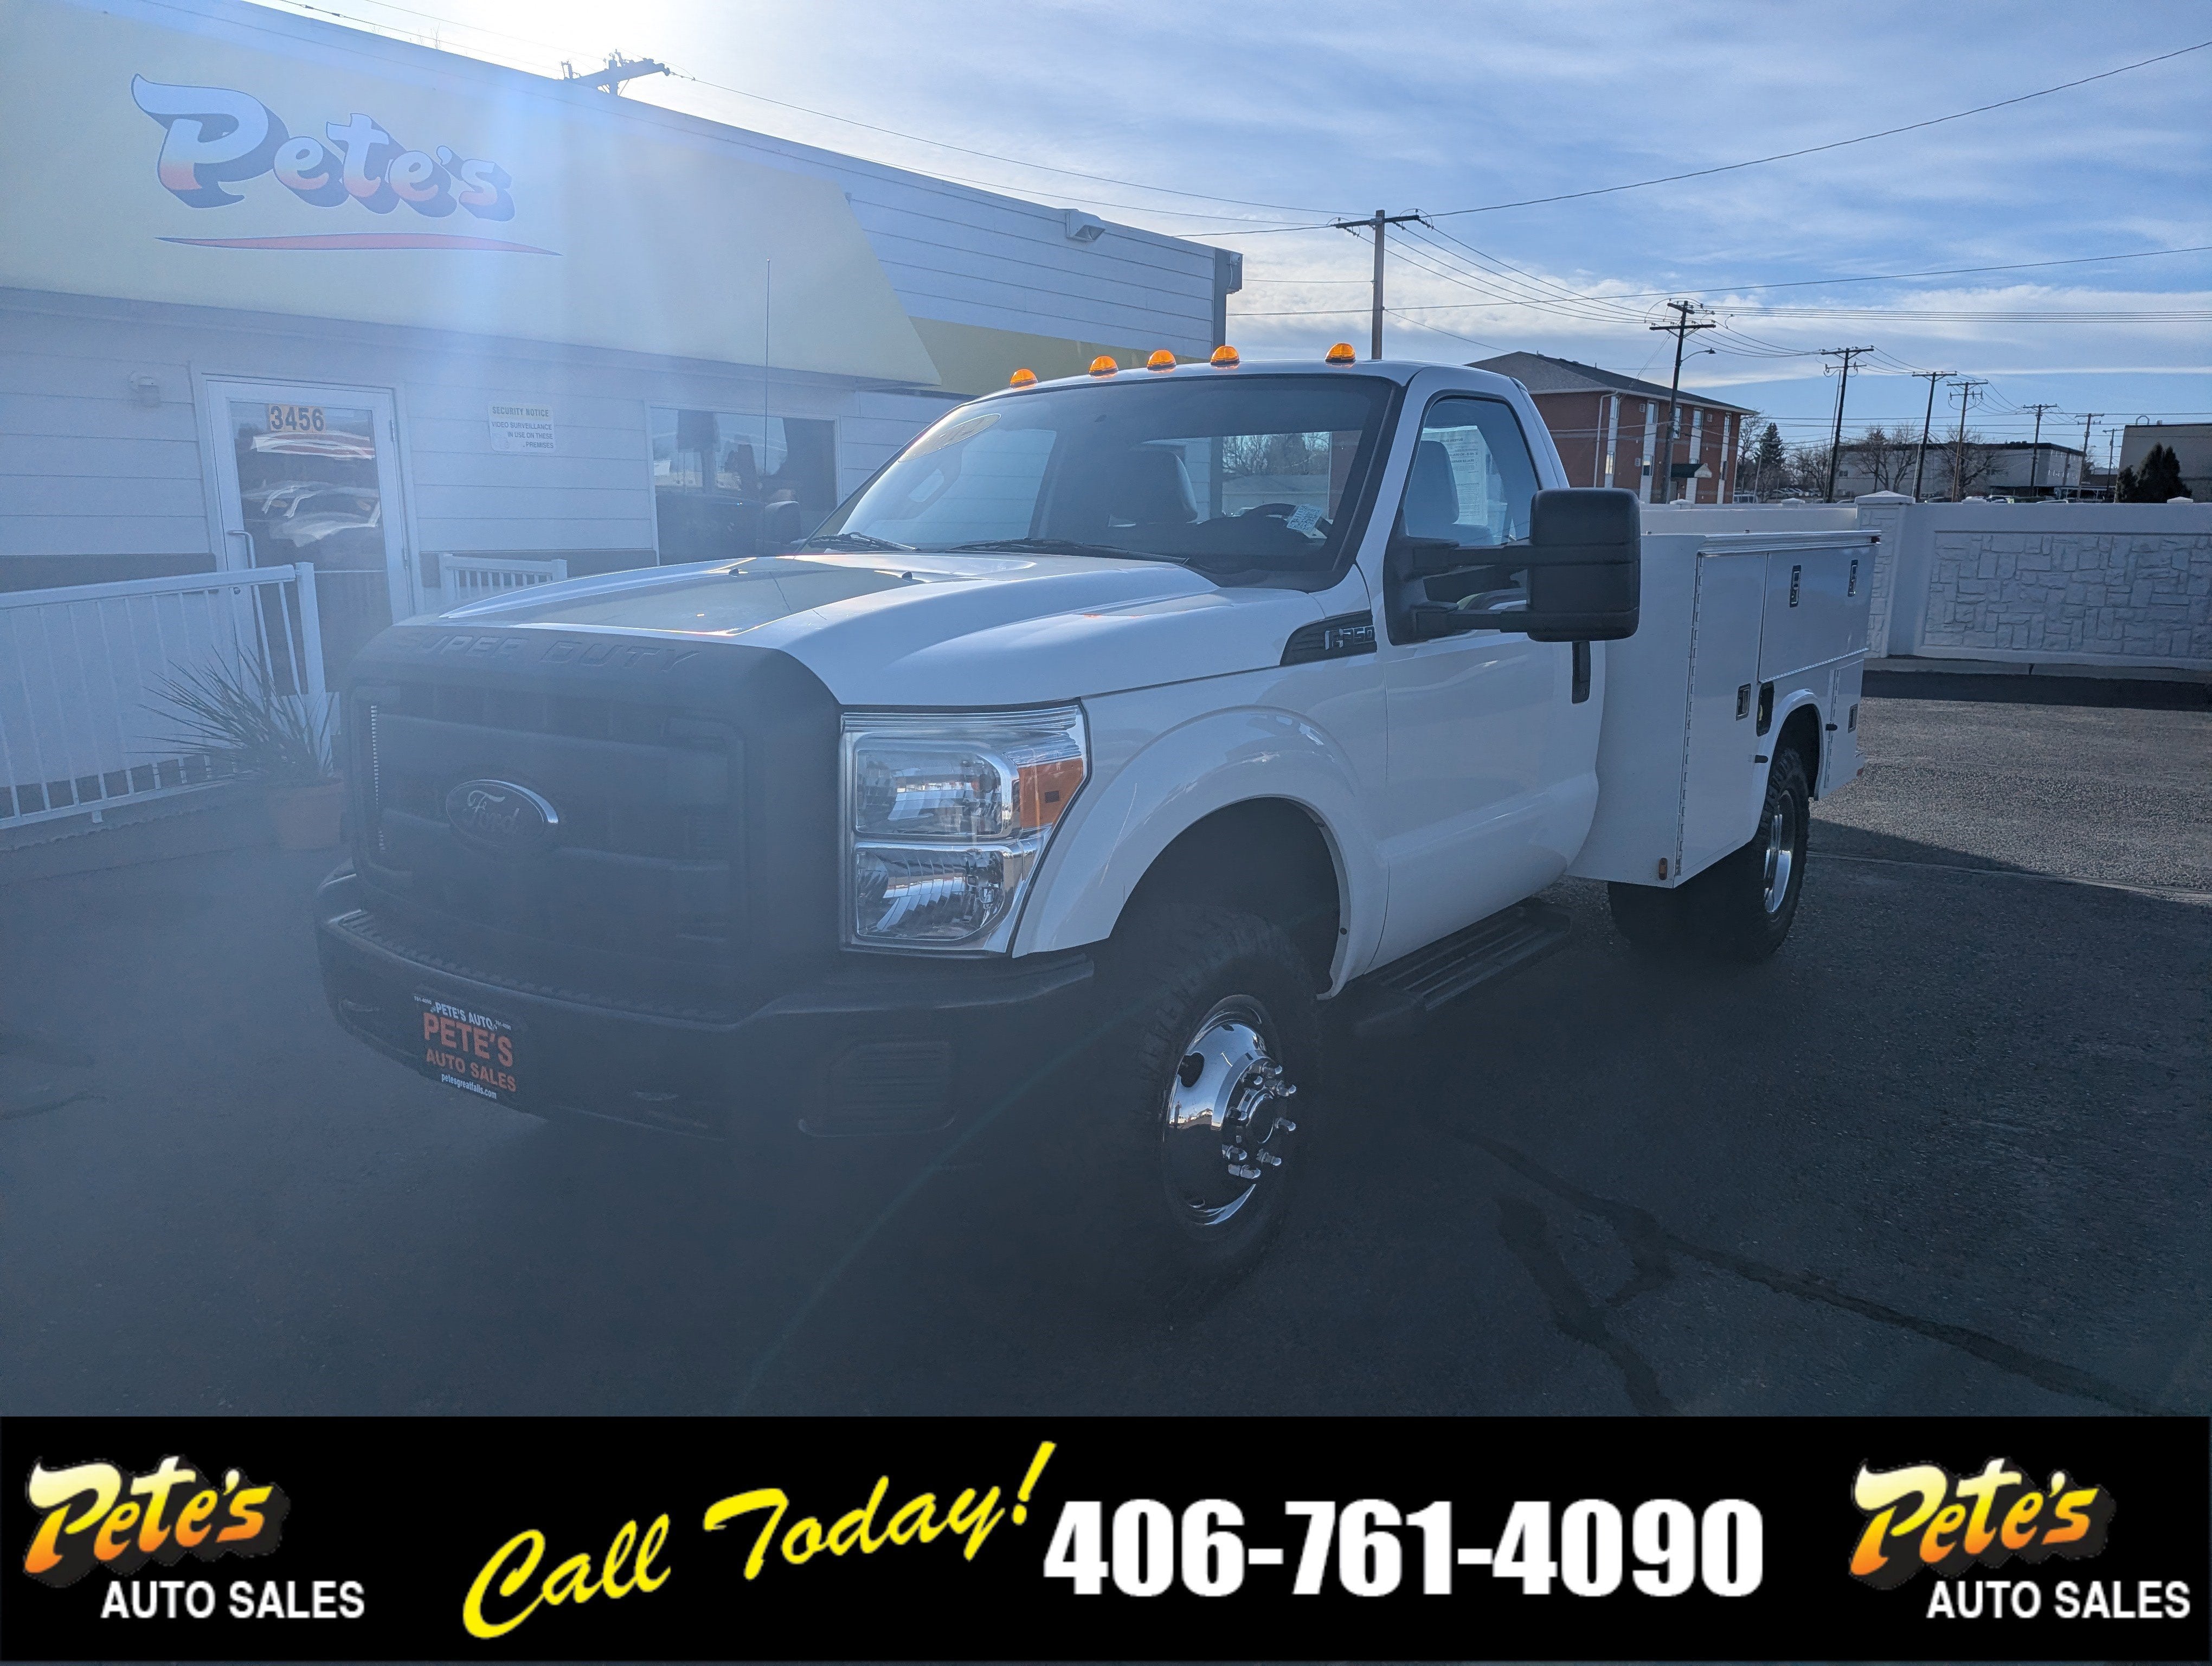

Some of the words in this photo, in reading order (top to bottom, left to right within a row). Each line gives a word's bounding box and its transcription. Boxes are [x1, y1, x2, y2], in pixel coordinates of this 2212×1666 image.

[131, 74, 510, 217] Pete's
[271, 406, 324, 432] 3456
[492, 406, 524, 415] SECURITY
[525, 408, 549, 417] NOTICE
[510, 422, 552, 430] SURVEILLANCE
[539, 641, 703, 672] DUTY
[462, 789, 520, 835] Ford
[435, 1002, 466, 1022] PETE'S
[468, 1012, 493, 1030] AUTO
[423, 1012, 513, 1067] PETE'S
[427, 1048, 466, 1074] AUTO
[470, 1062, 516, 1092] SALES
[441, 1073, 497, 1099] petesgreatfalls.com
